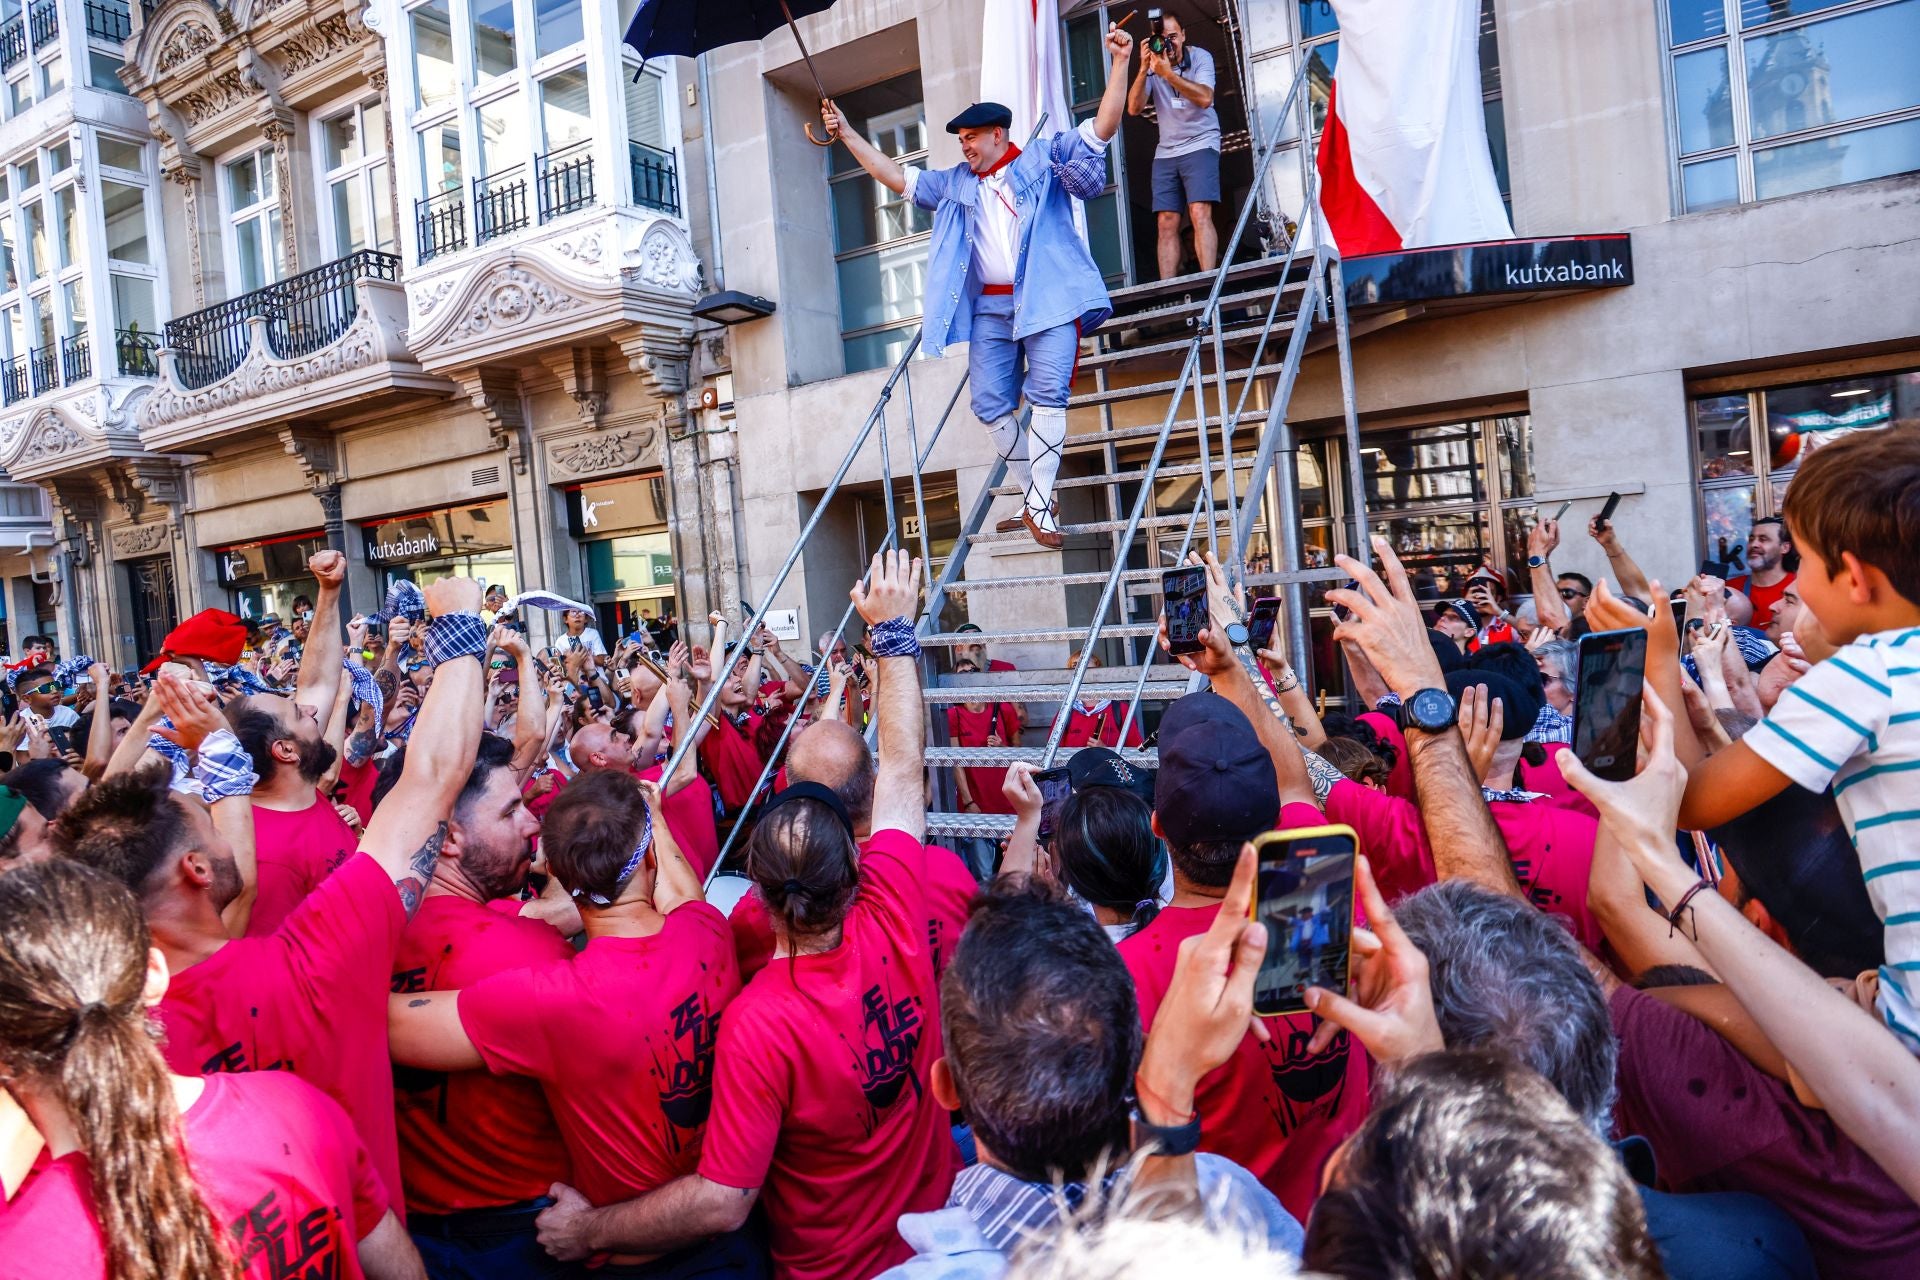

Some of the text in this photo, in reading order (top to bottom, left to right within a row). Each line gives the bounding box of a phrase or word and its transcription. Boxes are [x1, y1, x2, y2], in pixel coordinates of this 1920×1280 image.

[1505, 258, 1624, 285] kutxabank
[580, 495, 598, 528] k
[368, 533, 438, 561] kutxabank
[238, 591, 252, 620] k
